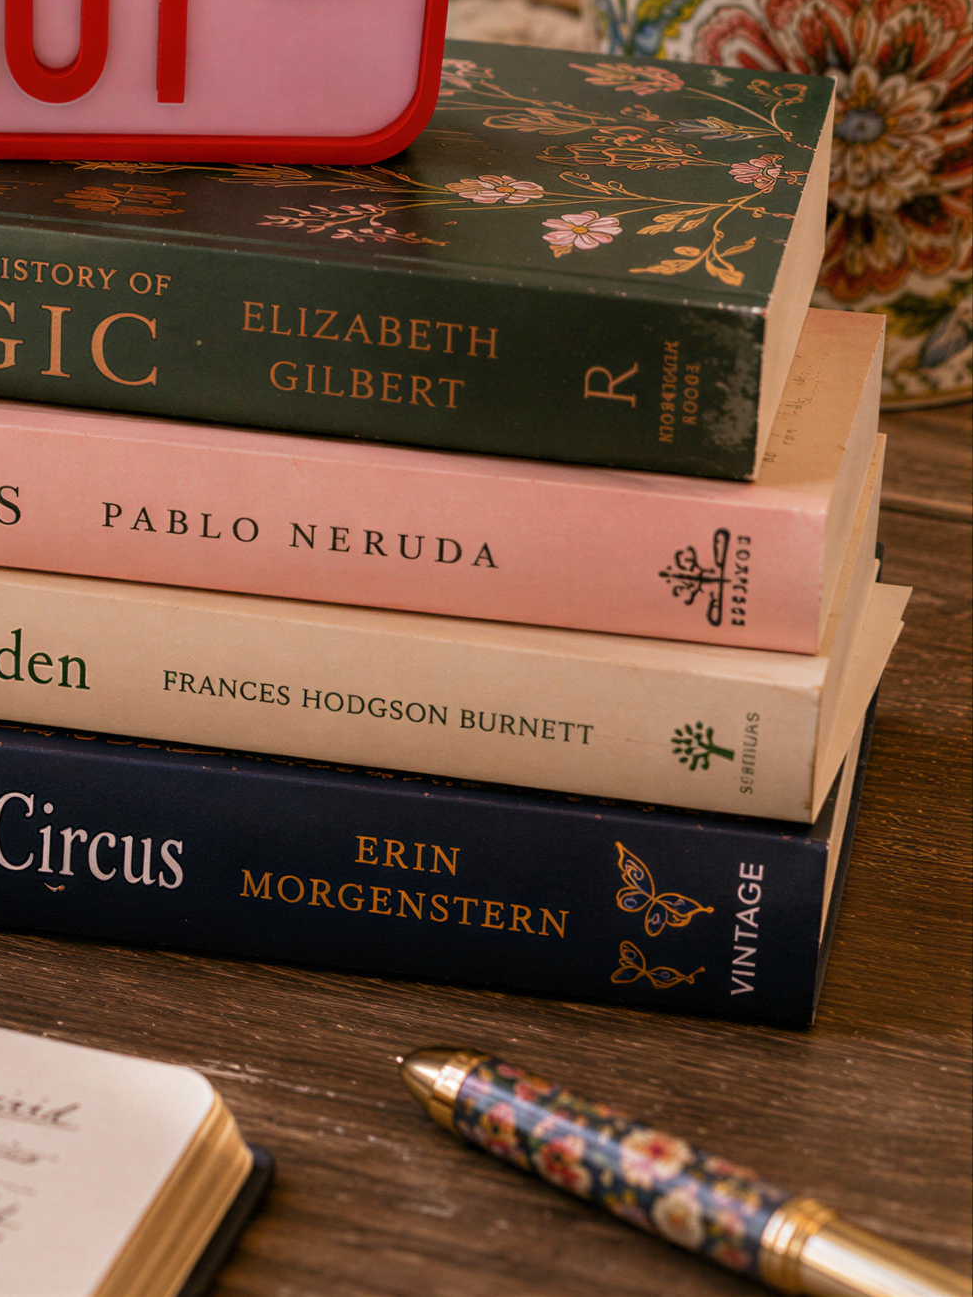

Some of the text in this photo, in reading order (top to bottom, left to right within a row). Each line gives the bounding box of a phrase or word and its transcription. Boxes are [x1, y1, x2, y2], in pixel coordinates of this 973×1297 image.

[128, 272, 171, 297] OF
[242, 301, 500, 361] ELIZABETH
[269, 360, 465, 410] GILBERT
[584, 362, 640, 408] R
[101, 501, 500, 570] PABLO NERUDA
[162, 669, 595, 746] FRANCES HODGSON BURNETT
[354, 834, 462, 877] ERIN
[239, 869, 571, 940] MORGENSTERN
[730, 861, 765, 996] VINTAGE
